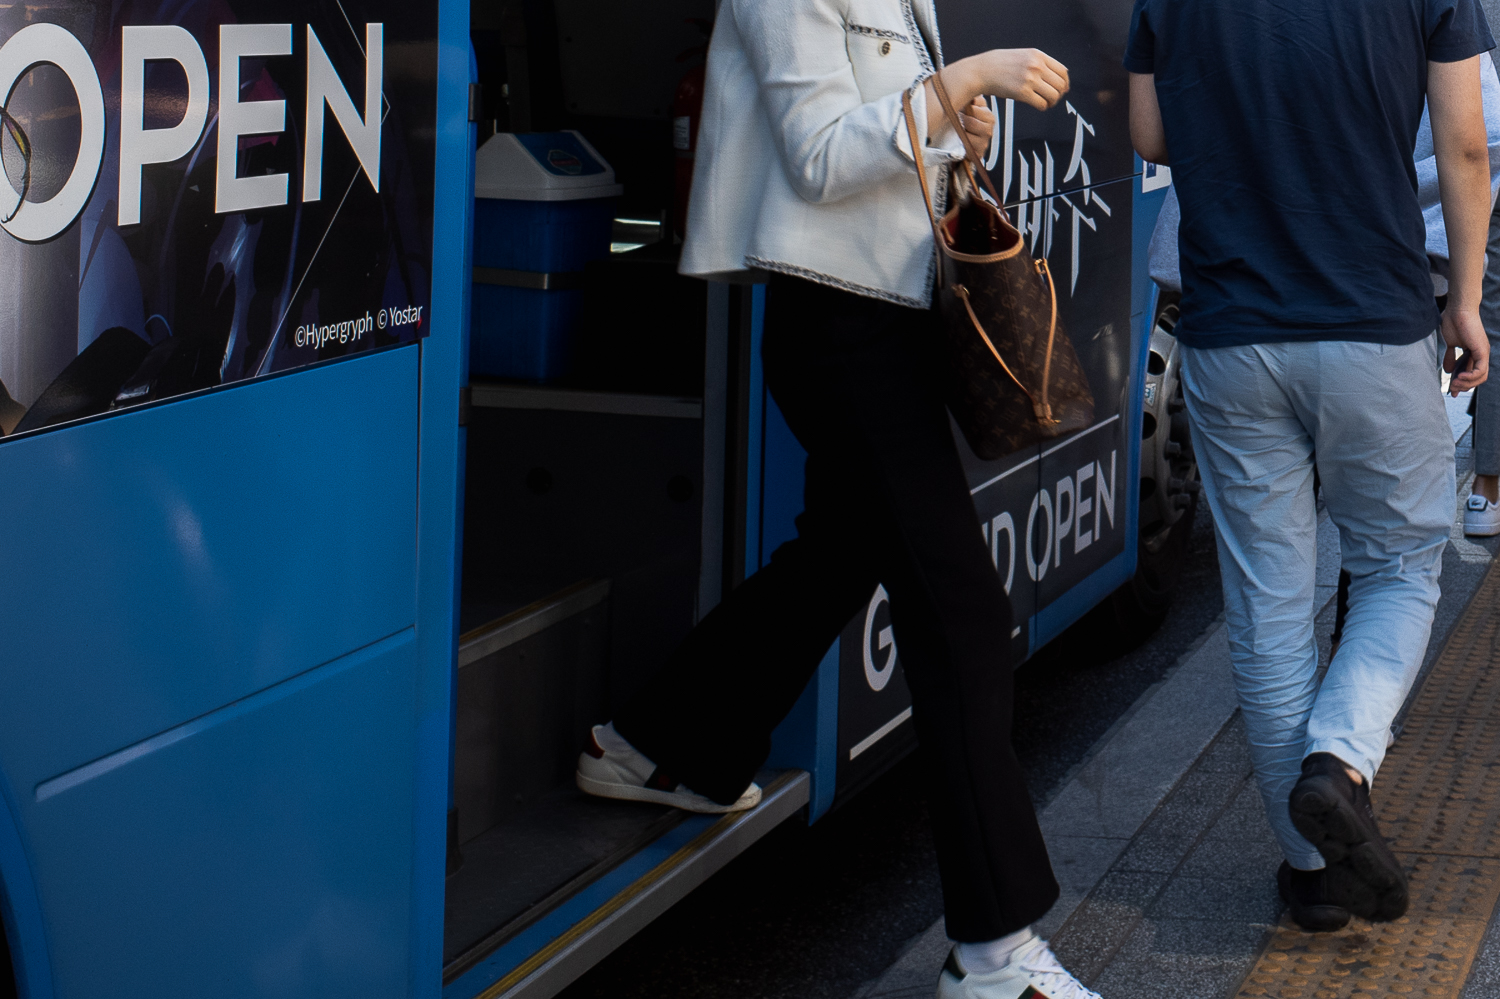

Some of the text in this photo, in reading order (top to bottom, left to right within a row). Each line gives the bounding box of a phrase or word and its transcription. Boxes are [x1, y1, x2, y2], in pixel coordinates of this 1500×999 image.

[0, 22, 383, 243] OPEN
[295, 310, 373, 350] ©Hypergryph
[389, 305, 423, 327] Yostar
[1026, 449, 1116, 582] OPEN
